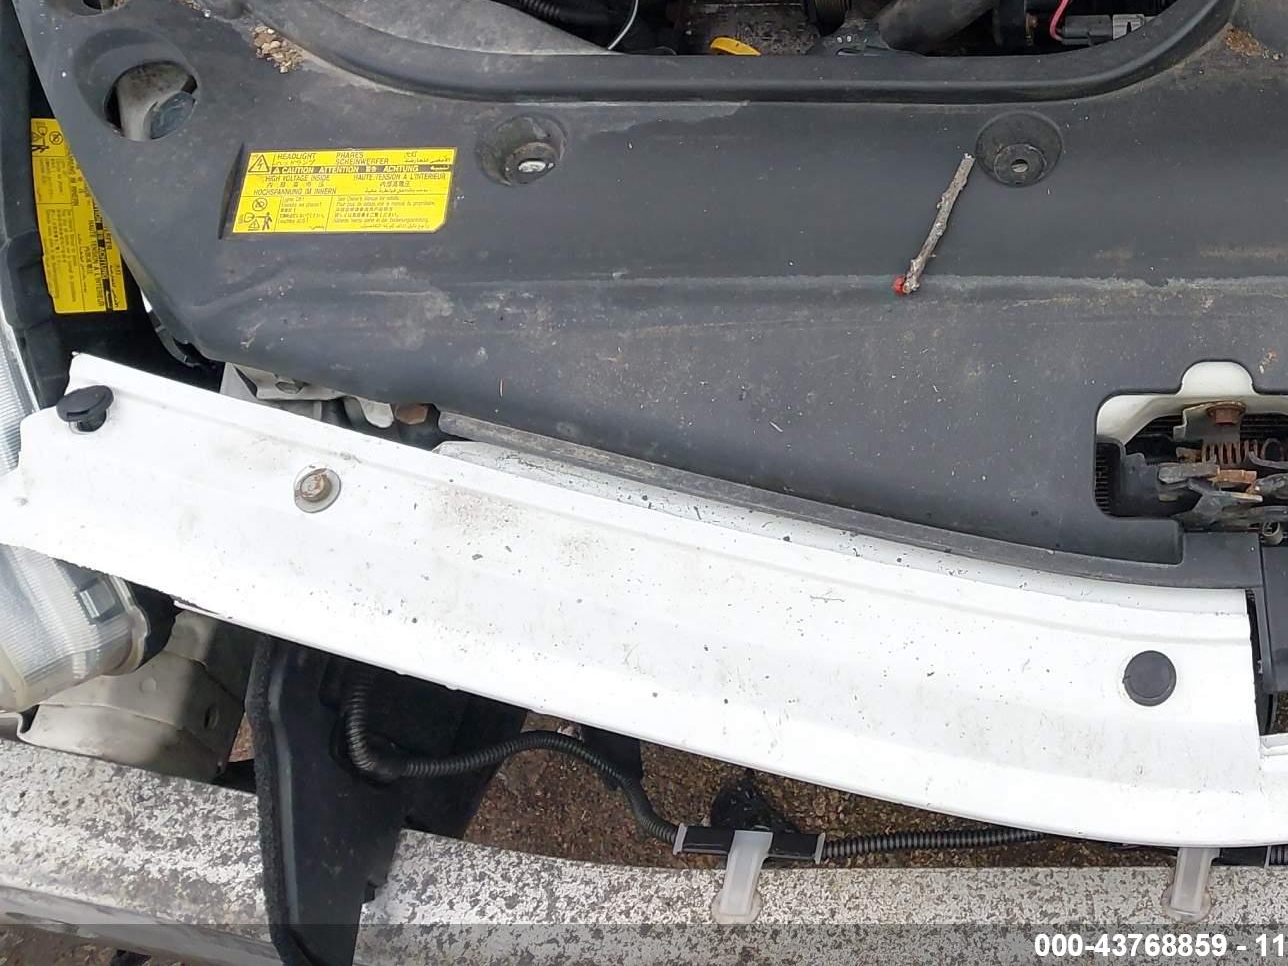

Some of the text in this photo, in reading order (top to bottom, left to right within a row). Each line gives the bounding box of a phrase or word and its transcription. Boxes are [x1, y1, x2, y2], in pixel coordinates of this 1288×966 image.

[277, 152, 317, 160] HEADLIGHT
[336, 157, 389, 165] SCHEINWERFER
[281, 166, 314, 174] CAUTION
[318, 165, 359, 174] ATTENTION
[383, 165, 419, 173] ACHTUNG
[353, 173, 373, 181] HAUTE
[375, 173, 400, 181] TENSION
